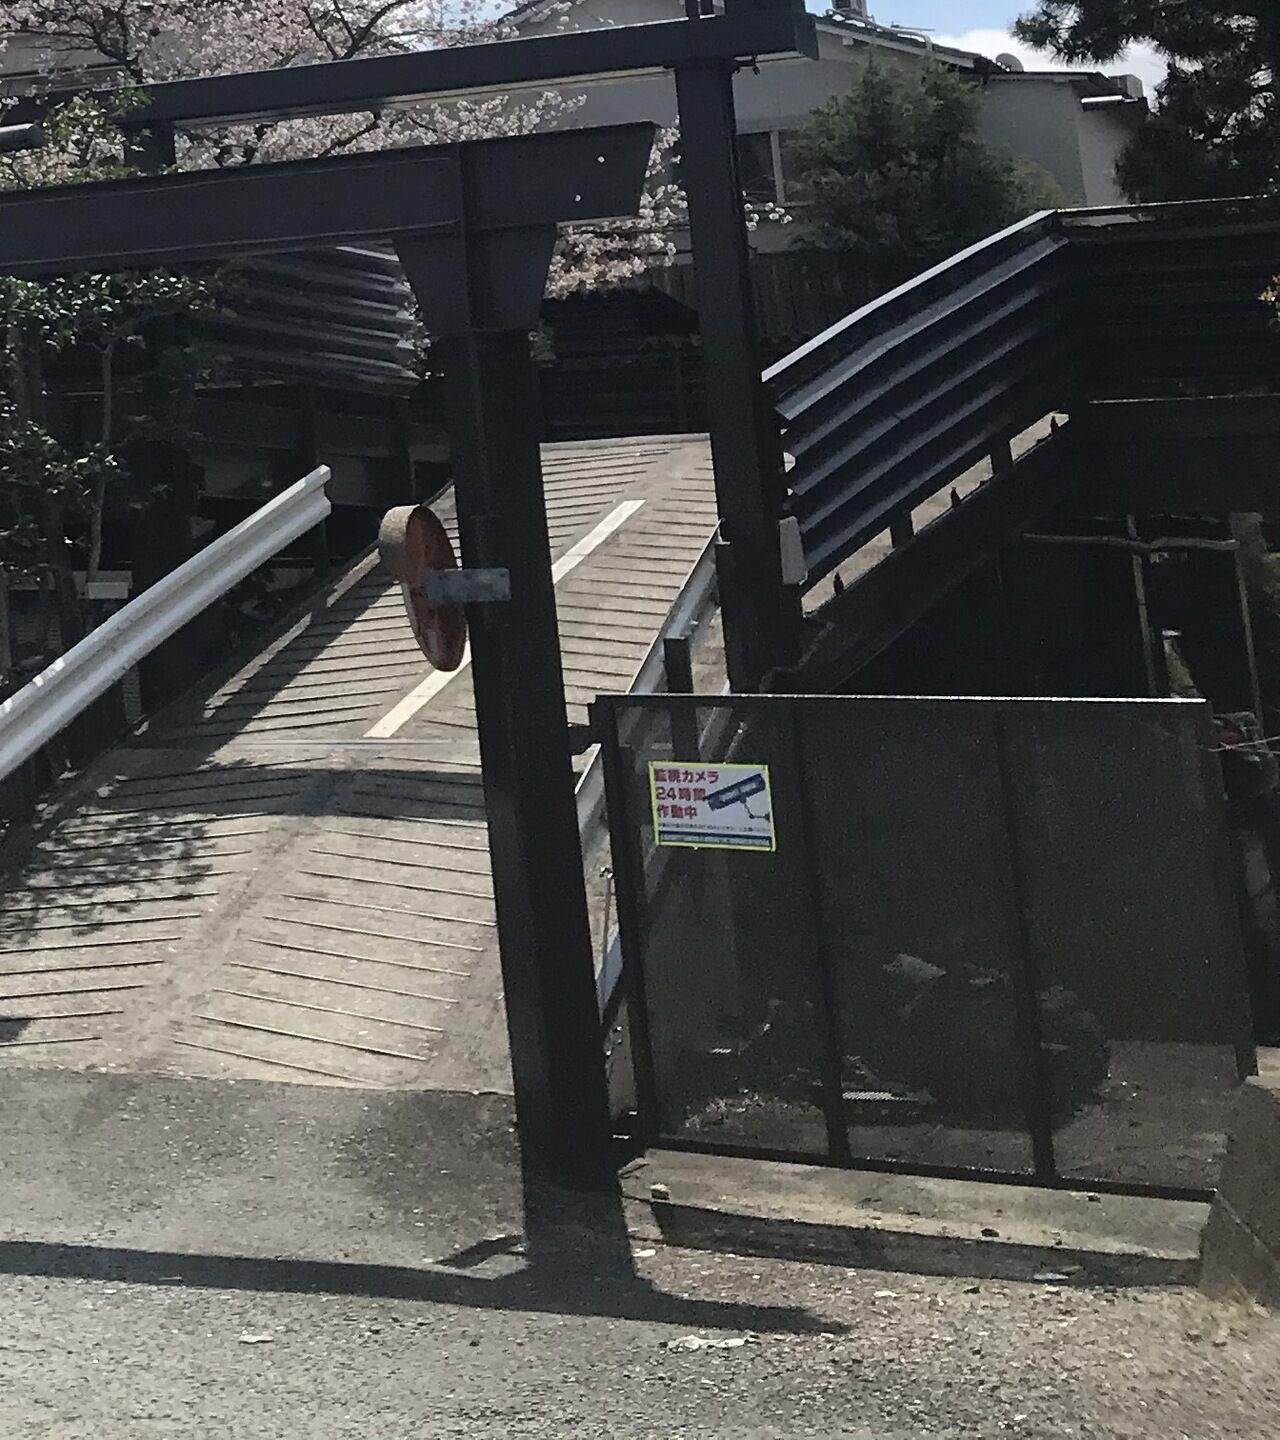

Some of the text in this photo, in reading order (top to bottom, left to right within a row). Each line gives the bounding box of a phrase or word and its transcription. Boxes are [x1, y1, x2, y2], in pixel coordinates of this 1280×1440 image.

[654, 768, 719, 784] 監視カメラ
[656, 786, 706, 802] 24時間
[657, 804, 698, 819] 作動中
